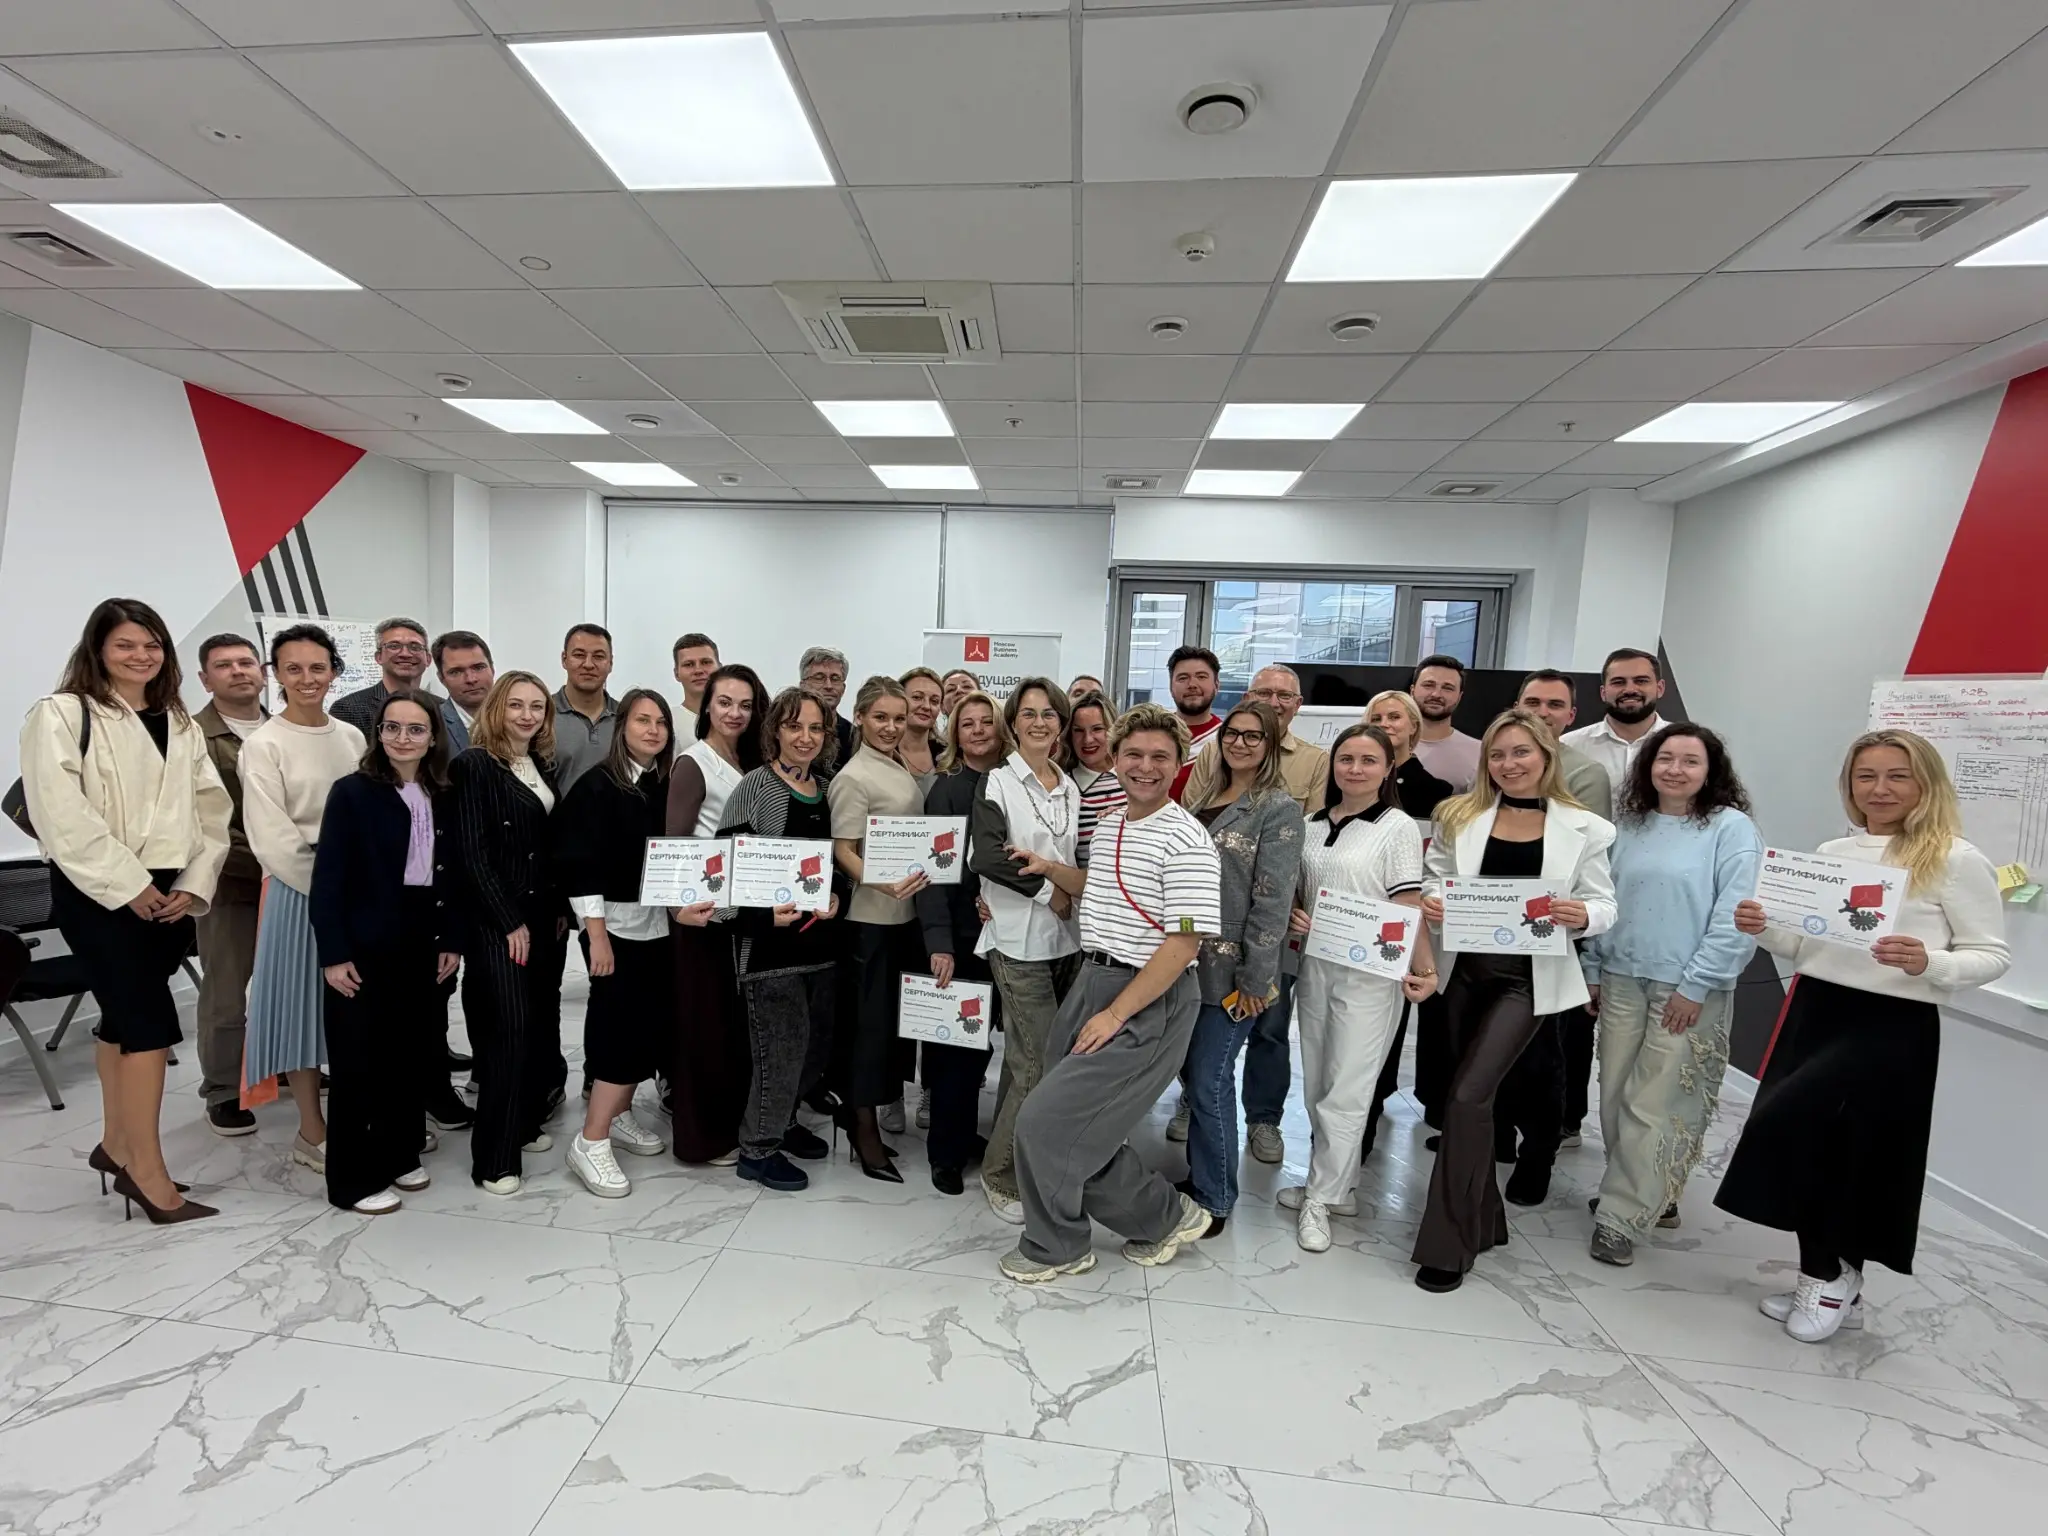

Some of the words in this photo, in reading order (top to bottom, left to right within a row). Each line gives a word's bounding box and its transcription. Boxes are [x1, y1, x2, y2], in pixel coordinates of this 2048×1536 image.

[978, 675, 1021, 688] дущая
[1319, 721, 1340, 740] Пр
[869, 830, 932, 838] СЕРТИФИКАТ
[736, 851, 797, 861] СЕРТИФИКАТ
[1763, 864, 1848, 885] СЕРТИФИКАТ
[1446, 893, 1521, 903] СЕРТИФИКАТ
[1317, 901, 1380, 922] СЕРТИФИКАТ
[903, 987, 958, 1001] СЕРТИФИКАТ
